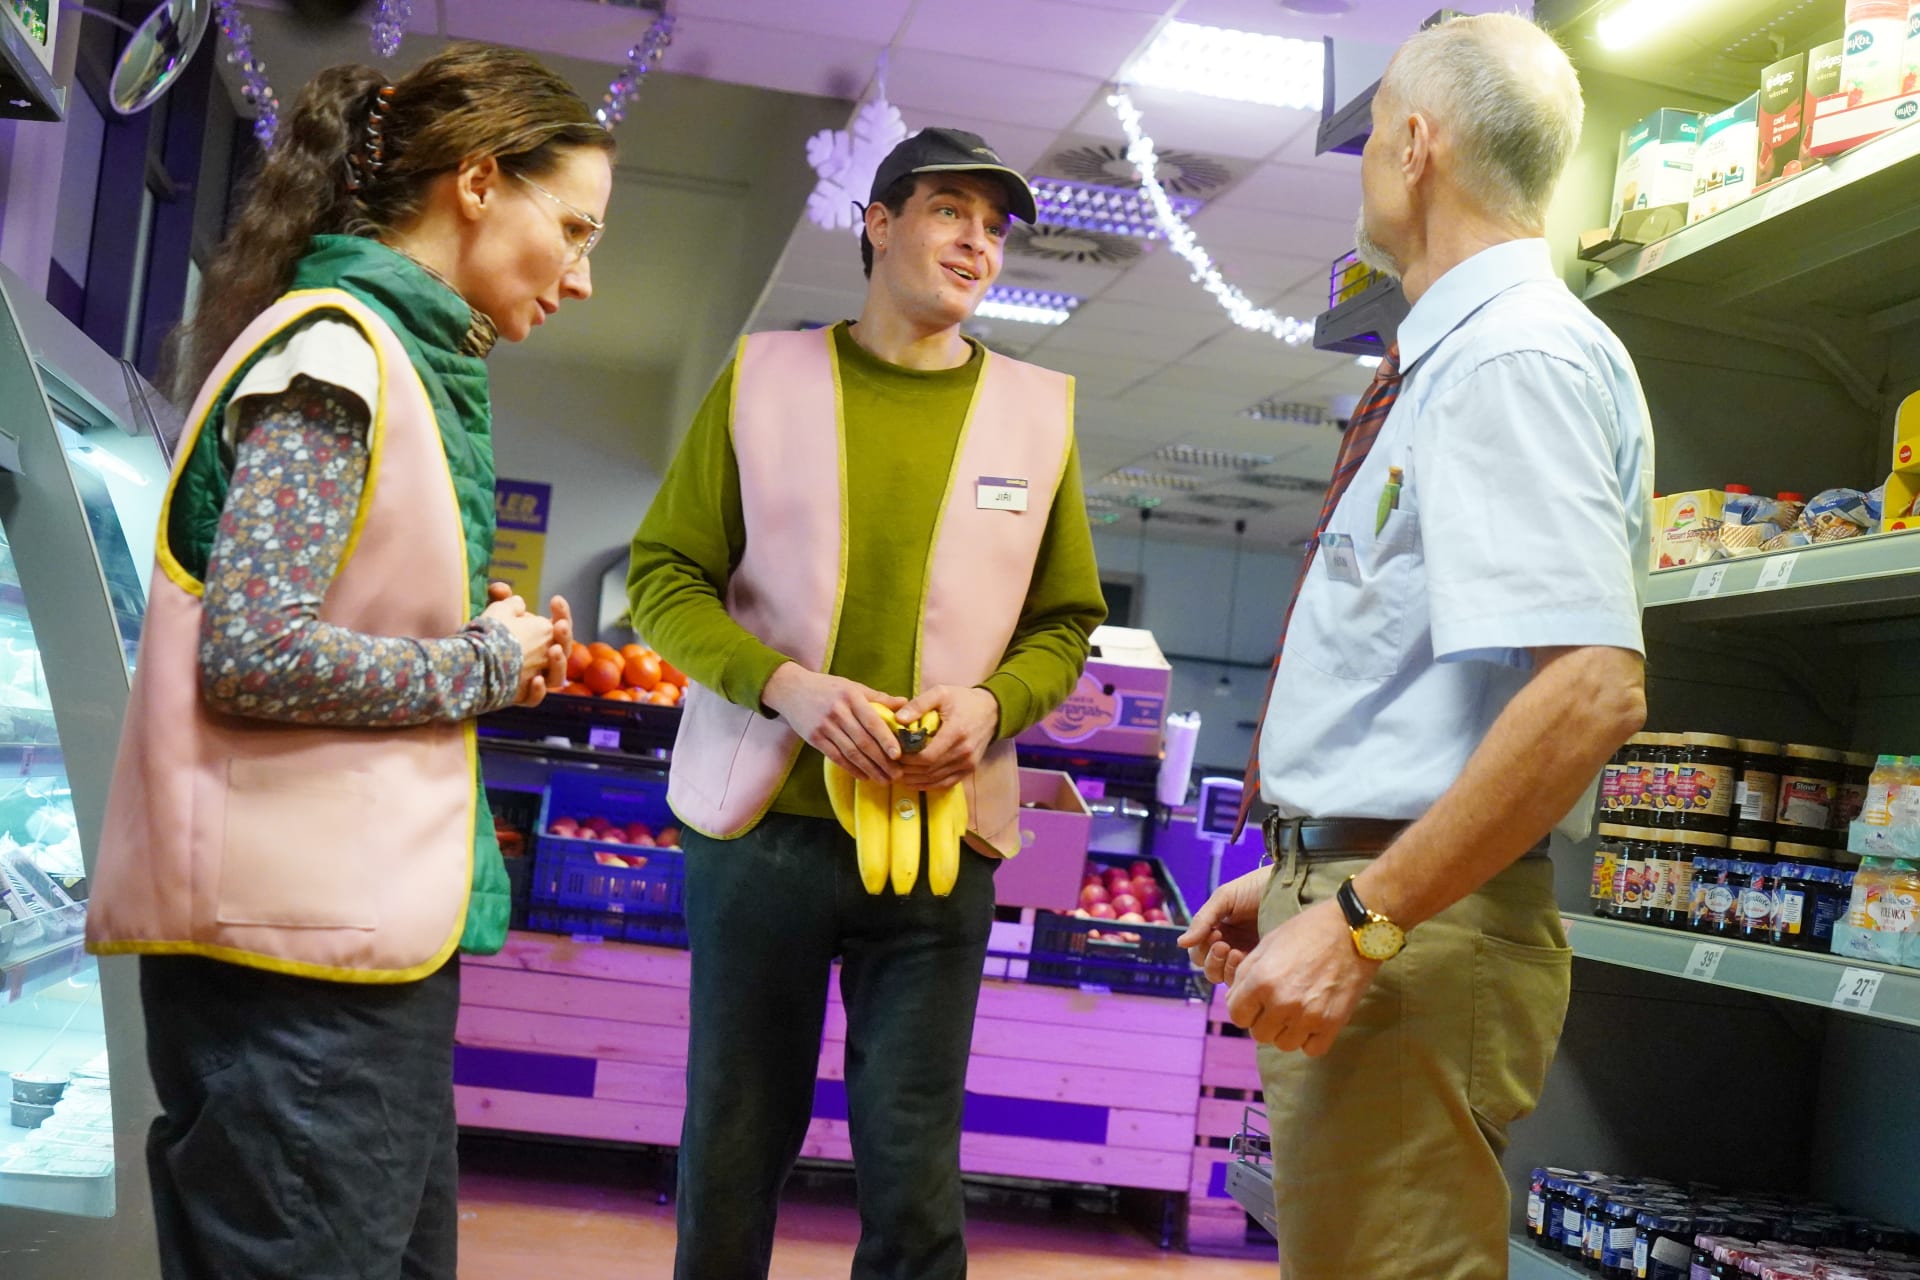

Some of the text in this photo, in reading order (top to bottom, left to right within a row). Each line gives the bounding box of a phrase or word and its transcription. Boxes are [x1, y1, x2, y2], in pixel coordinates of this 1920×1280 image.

[1680, 123, 1698, 134] Gou
[1700, 950, 1714, 968] 39
[1852, 978, 1870, 997] 27
